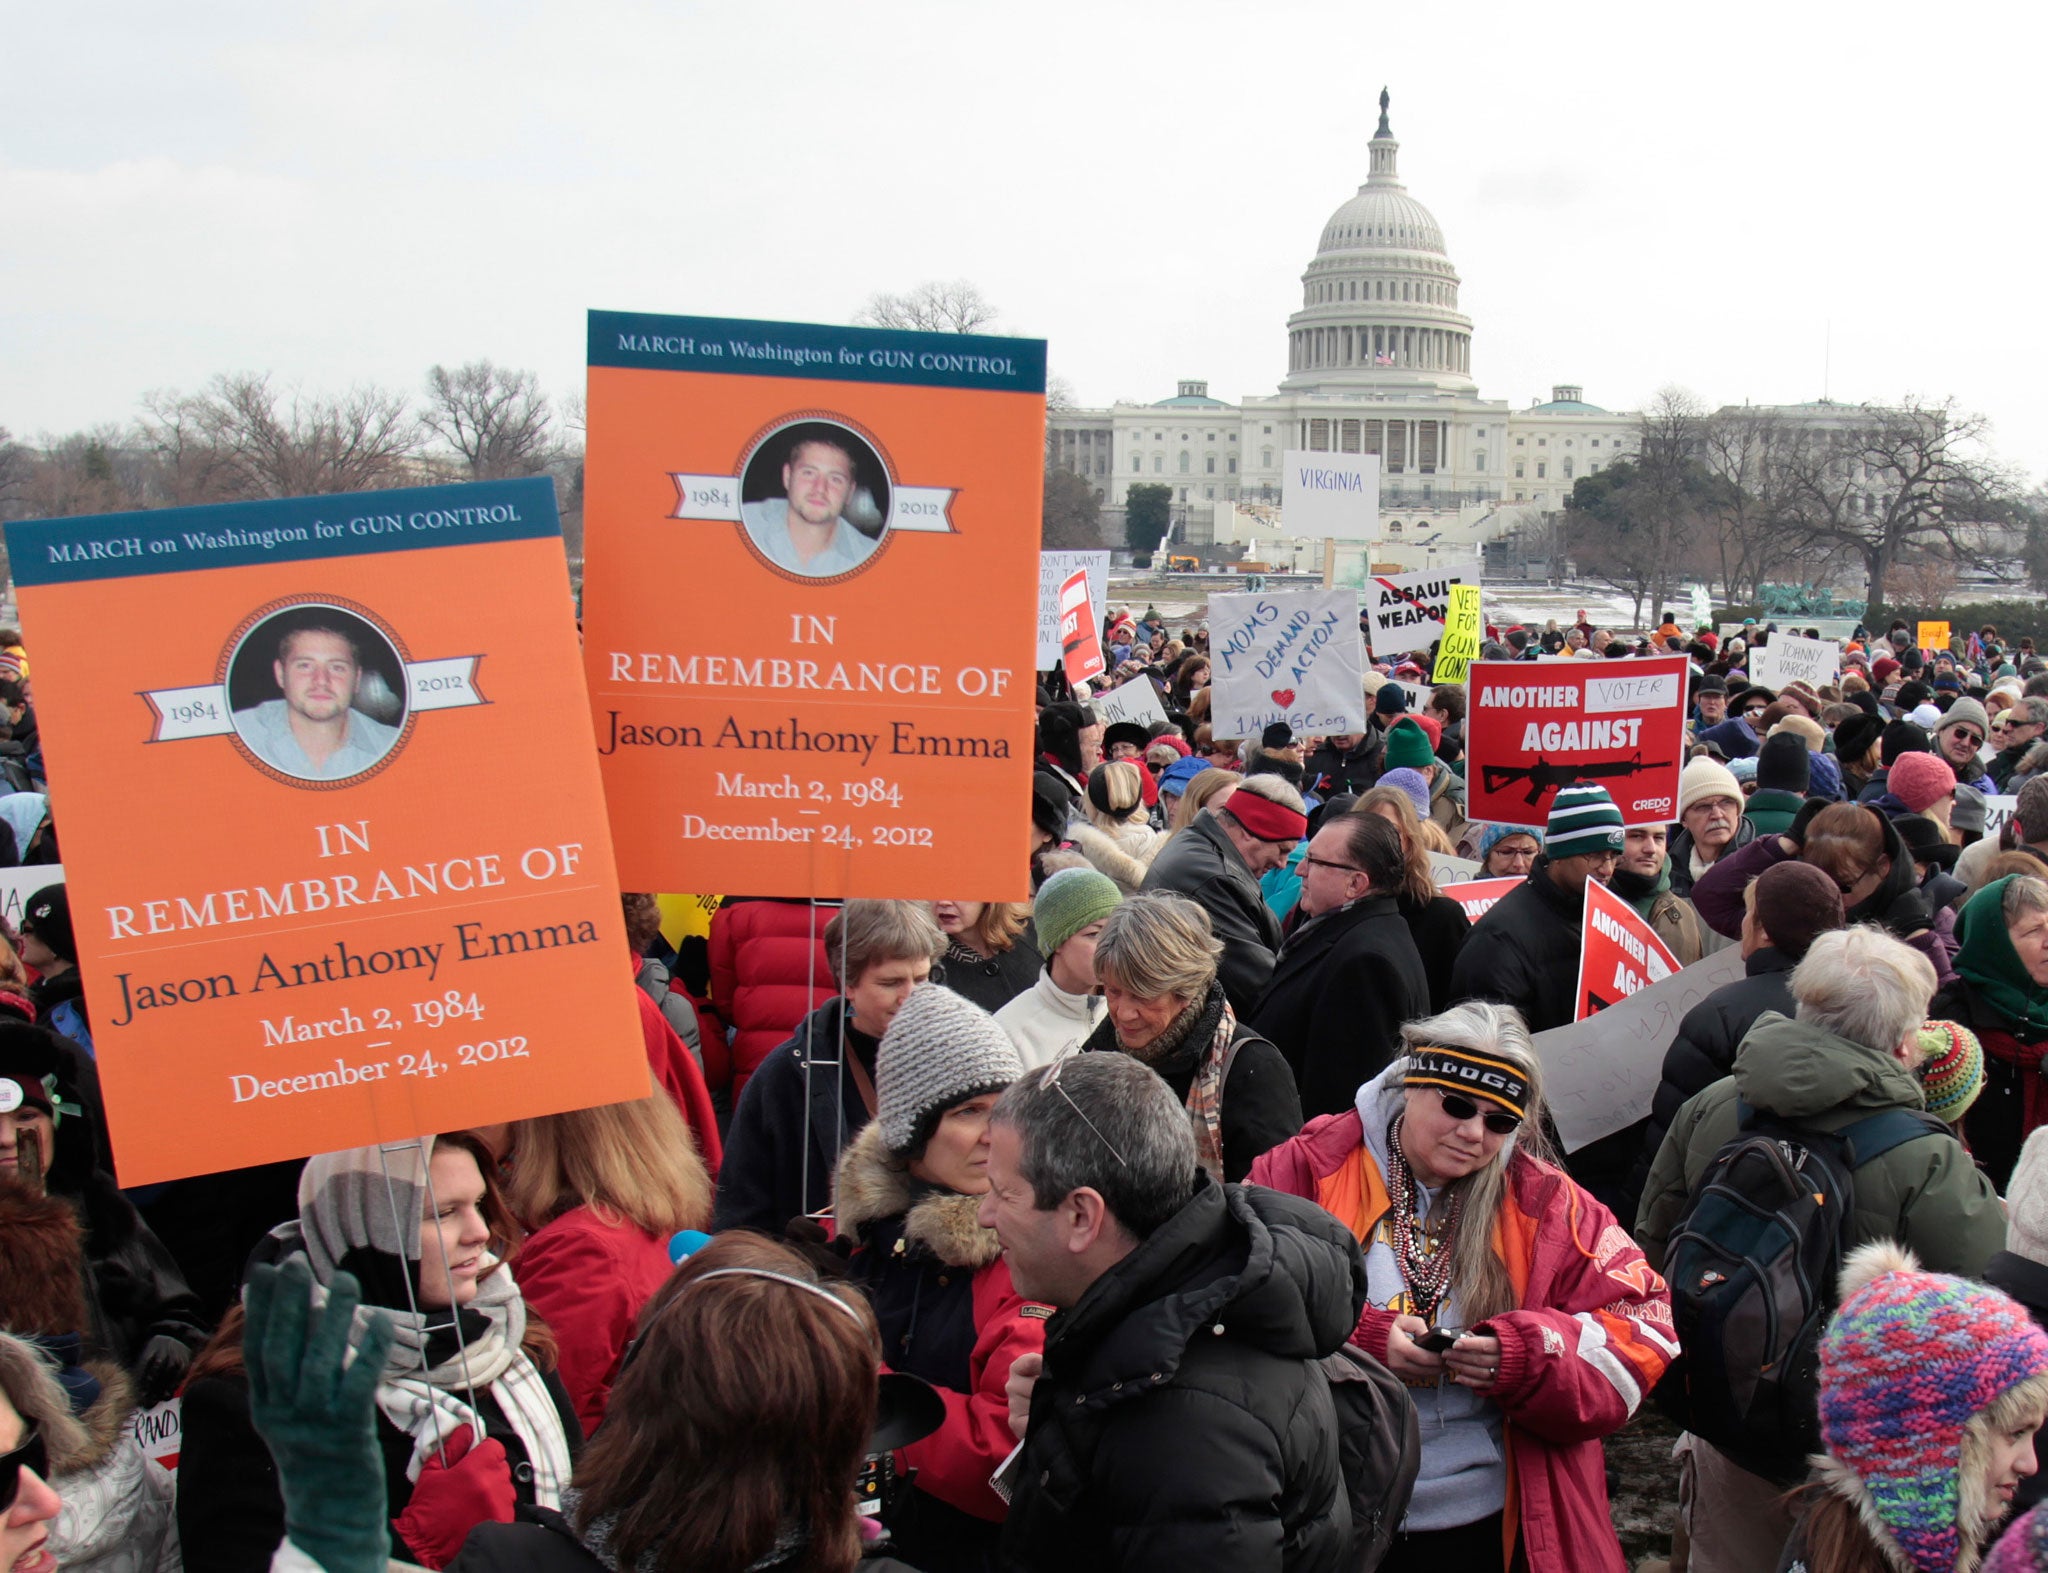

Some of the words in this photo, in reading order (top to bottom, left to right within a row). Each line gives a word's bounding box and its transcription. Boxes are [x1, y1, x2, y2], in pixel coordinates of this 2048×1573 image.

[618, 334, 695, 355] MARCH
[701, 343, 723, 357] on
[729, 340, 833, 367] Washington
[838, 347, 864, 365] for
[869, 350, 914, 369] GUN
[920, 353, 1016, 376] CONTROL
[1300, 467, 1362, 493] VIRGINIA
[693, 488, 730, 507] 1984
[900, 502, 938, 516] 2012
[48, 538, 143, 564] MARCH
[150, 539, 178, 554] on
[182, 527, 309, 551] Washington
[314, 520, 344, 539] for
[350, 515, 403, 536] GUN
[410, 504, 521, 530] CONTROL
[1041, 569, 1054, 580] TO
[1074, 555, 1102, 567] WANT
[1456, 589, 1478, 610] VETS
[790, 614, 837, 645] IN
[1221, 601, 1278, 672] MOMS
[1457, 613, 1477, 631] FOR
[1255, 610, 1310, 679] DEMAND
[1291, 611, 1339, 685] ACTION
[1445, 633, 1476, 656] GUN
[1780, 642, 1823, 662] JOHNNY
[417, 676, 463, 692] 2012
[609, 652, 941, 694] REMEMBRANCE
[957, 667, 1013, 697] OF
[1780, 660, 1818, 680] VARGAS
[1479, 685, 1579, 708] ANOTHER
[1598, 678, 1664, 704] VOTER
[171, 701, 219, 723] 1984
[598, 710, 704, 755] Jason
[712, 715, 879, 767] Anthony
[889, 721, 1011, 759] Emma
[1521, 718, 1642, 752] AGAINST
[715, 772, 801, 800] March
[808, 781, 832, 803] 2,
[841, 777, 903, 808] 1984
[1632, 797, 1671, 811] CREDO
[315, 821, 370, 857] IN
[682, 814, 815, 843] December
[821, 824, 863, 850] 24,
[872, 826, 933, 848] 2012
[105, 854, 505, 940] REMEMBRANCE
[521, 843, 583, 880] OF
[1591, 907, 1646, 966] ANOTHER
[111, 972, 240, 1027] Jason
[249, 941, 444, 993] Anthony
[453, 918, 599, 961] Emma
[259, 1007, 366, 1047] March
[372, 1008, 403, 1031] 2,
[412, 990, 485, 1028] 1984
[228, 1058, 390, 1103] December
[397, 1049, 448, 1079] 24,
[457, 1036, 530, 1067] 2012
[1409, 1057, 1522, 1097] ULLDOGS
